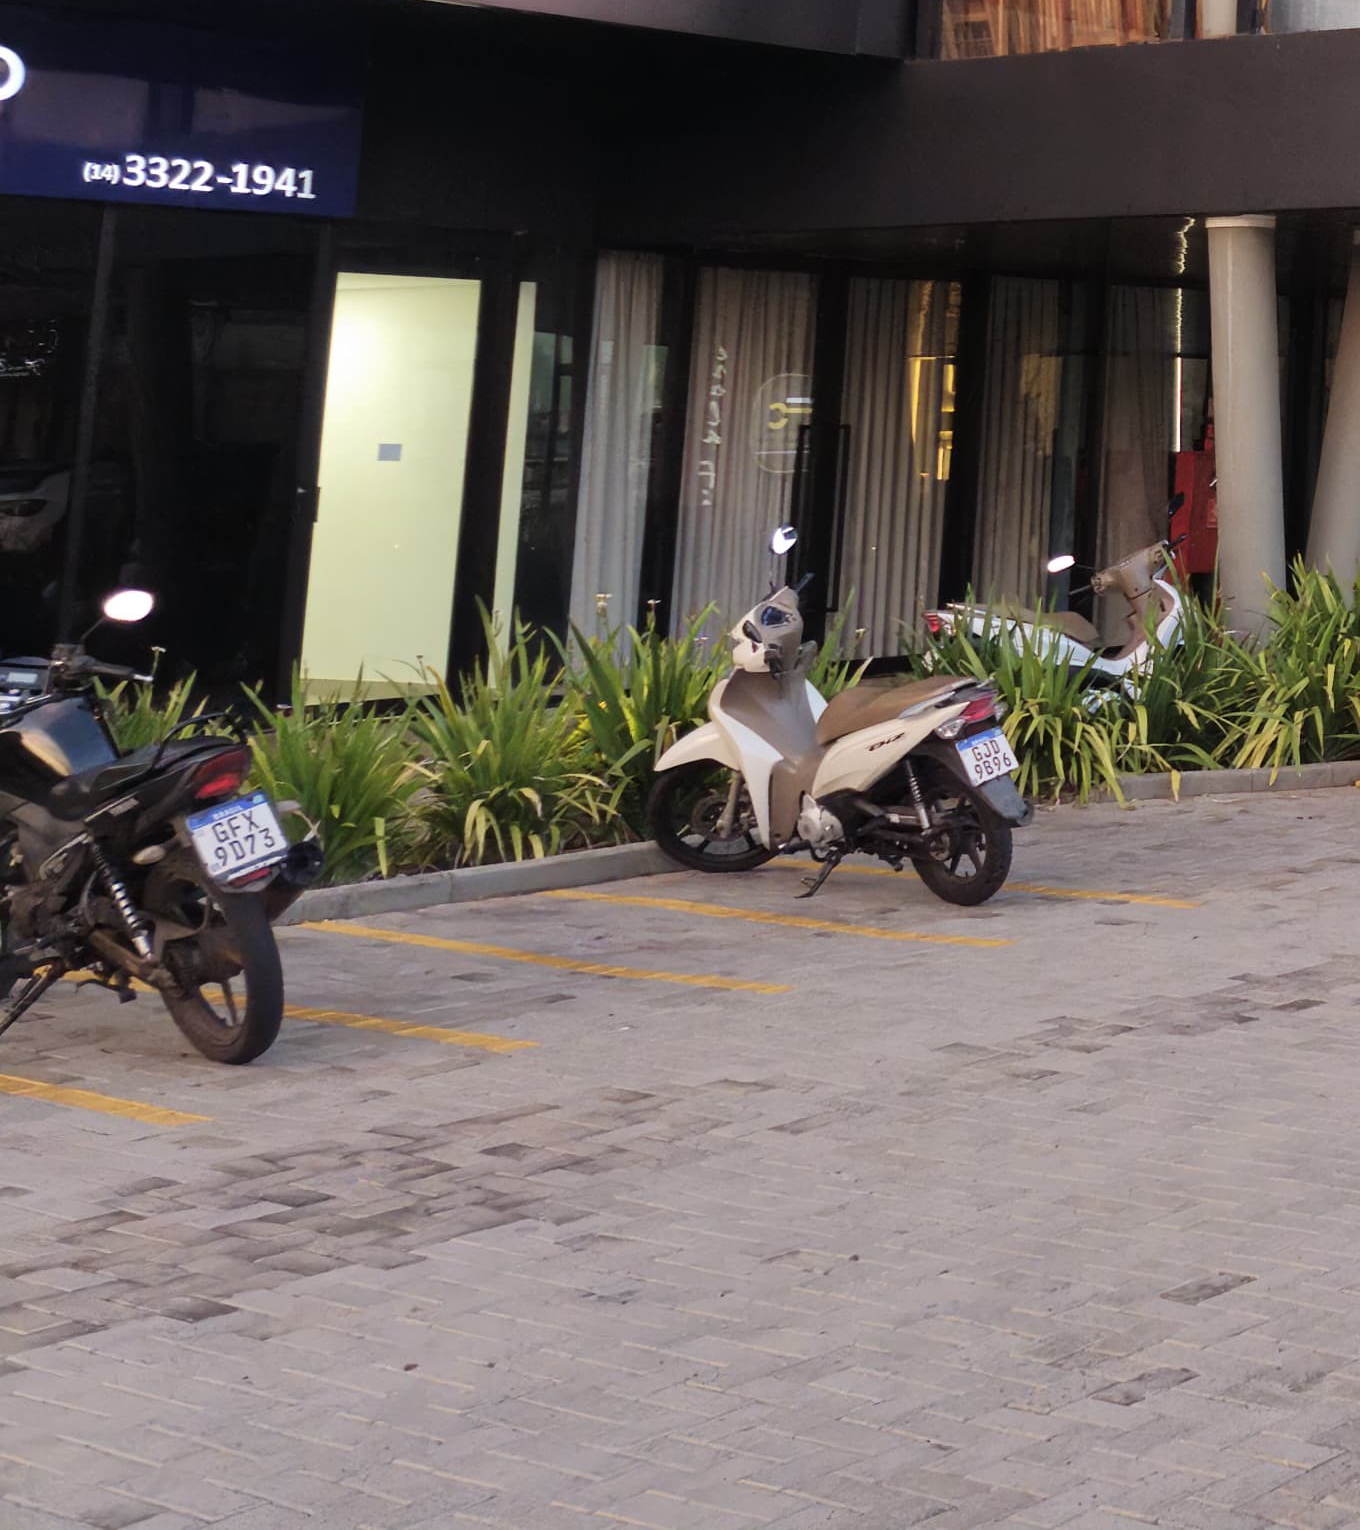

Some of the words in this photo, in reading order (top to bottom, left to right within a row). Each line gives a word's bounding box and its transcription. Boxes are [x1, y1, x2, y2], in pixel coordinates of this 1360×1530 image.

[83, 161, 120, 185] (14)
[122, 154, 317, 200] 3322-1941
[971, 739, 1001, 762] GJD
[974, 752, 1012, 780] 9B96
[211, 810, 259, 843] GFX
[214, 827, 275, 867] 9D73
